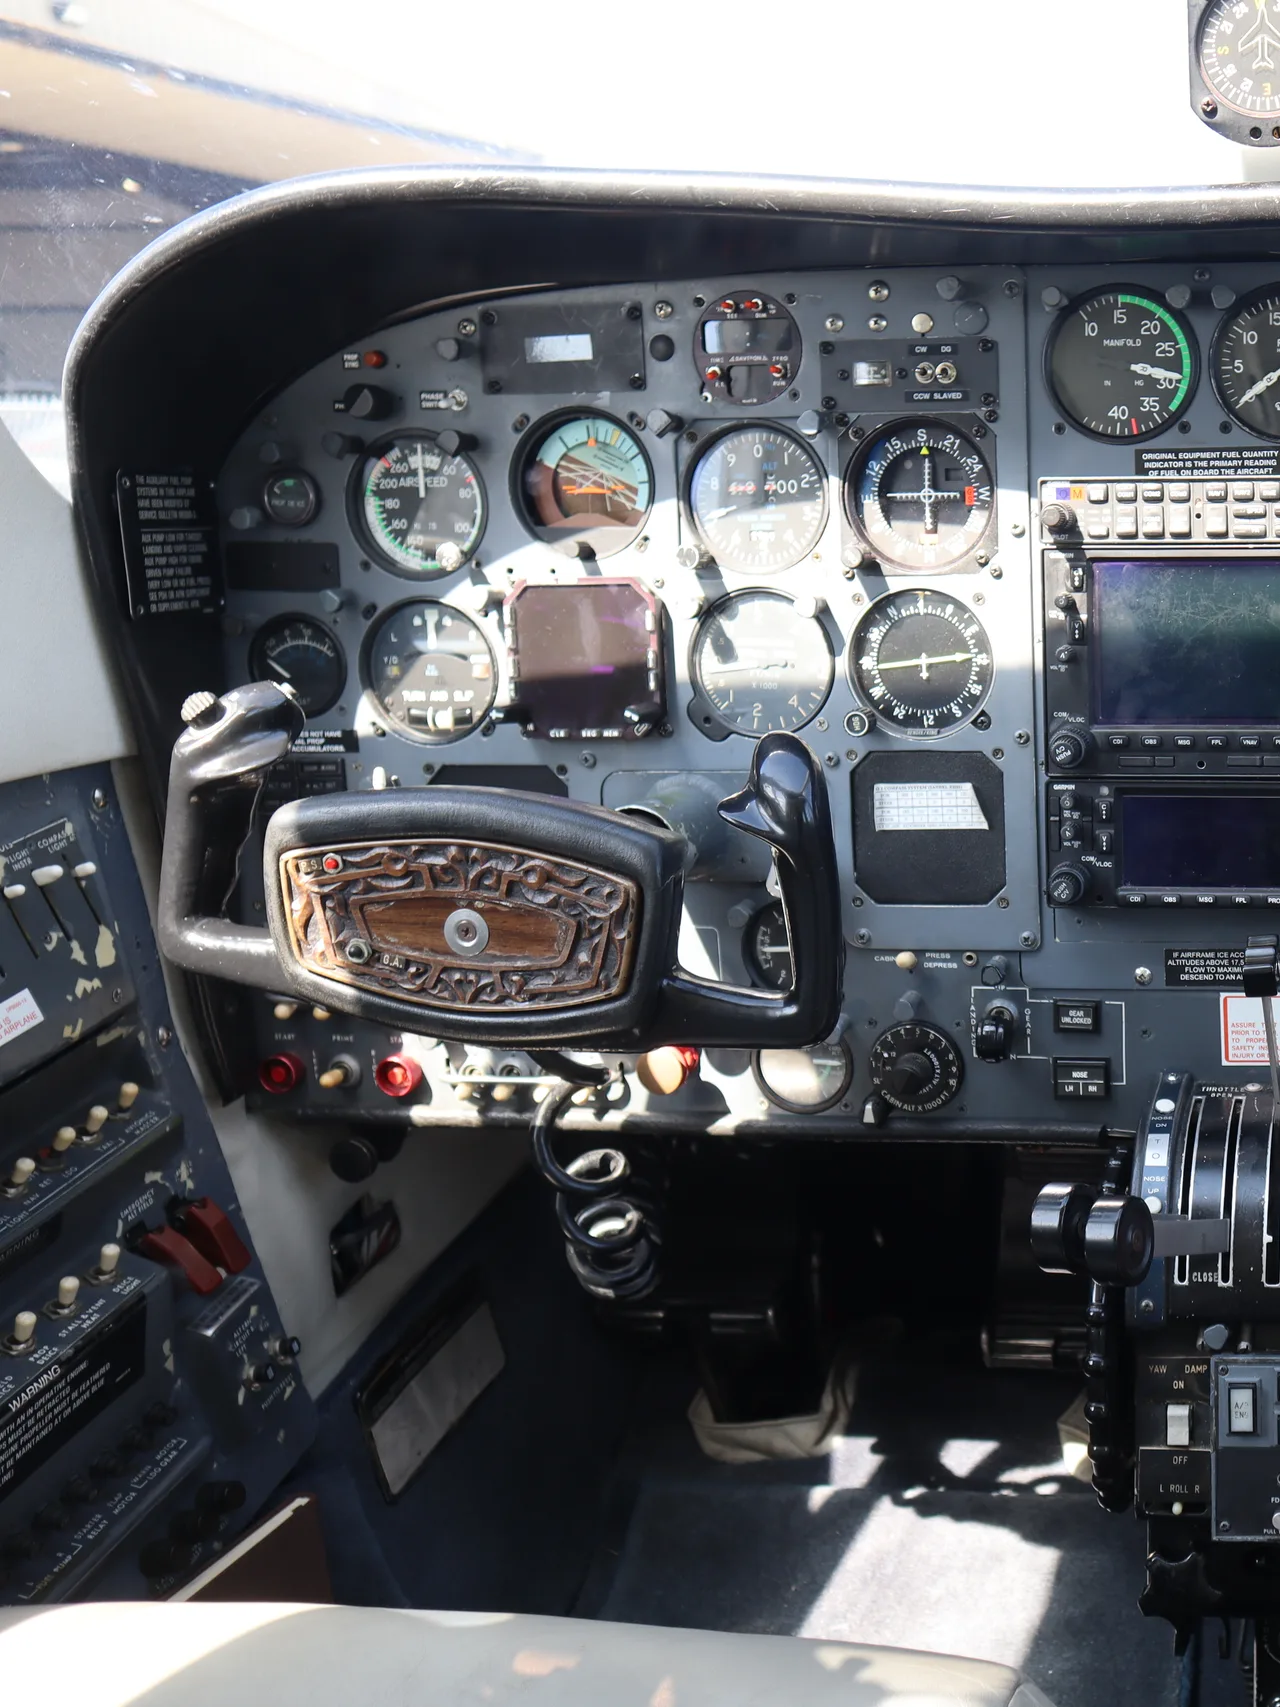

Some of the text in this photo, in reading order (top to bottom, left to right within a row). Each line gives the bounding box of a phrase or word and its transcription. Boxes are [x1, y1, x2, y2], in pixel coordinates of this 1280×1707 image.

[1114, 309, 1126, 323] 15
[1085, 323, 1098, 336] 10
[1141, 322, 1160, 335] 20
[1103, 339, 1141, 347] MANIFOLD
[1243, 332, 1257, 344] 10
[1156, 343, 1175, 356] 25
[1139, 398, 1159, 410] 35
[1108, 406, 1128, 419] 40
[917, 429, 927, 441] S
[944, 436, 961, 449] 21
[1242, 451, 1279, 459] QUANTITY
[1210, 460, 1239, 468] PRIMARY
[1241, 459, 1277, 467] READING
[380, 479, 397, 489] 200
[459, 489, 471, 498] 80
[385, 499, 400, 509] 180
[392, 519, 407, 529] 160
[455, 523, 470, 532] 100
[9, 1365, 61, 1412] WARNING
[1173, 1381, 1185, 1389] ON
[1172, 1456, 1188, 1465] OFF
